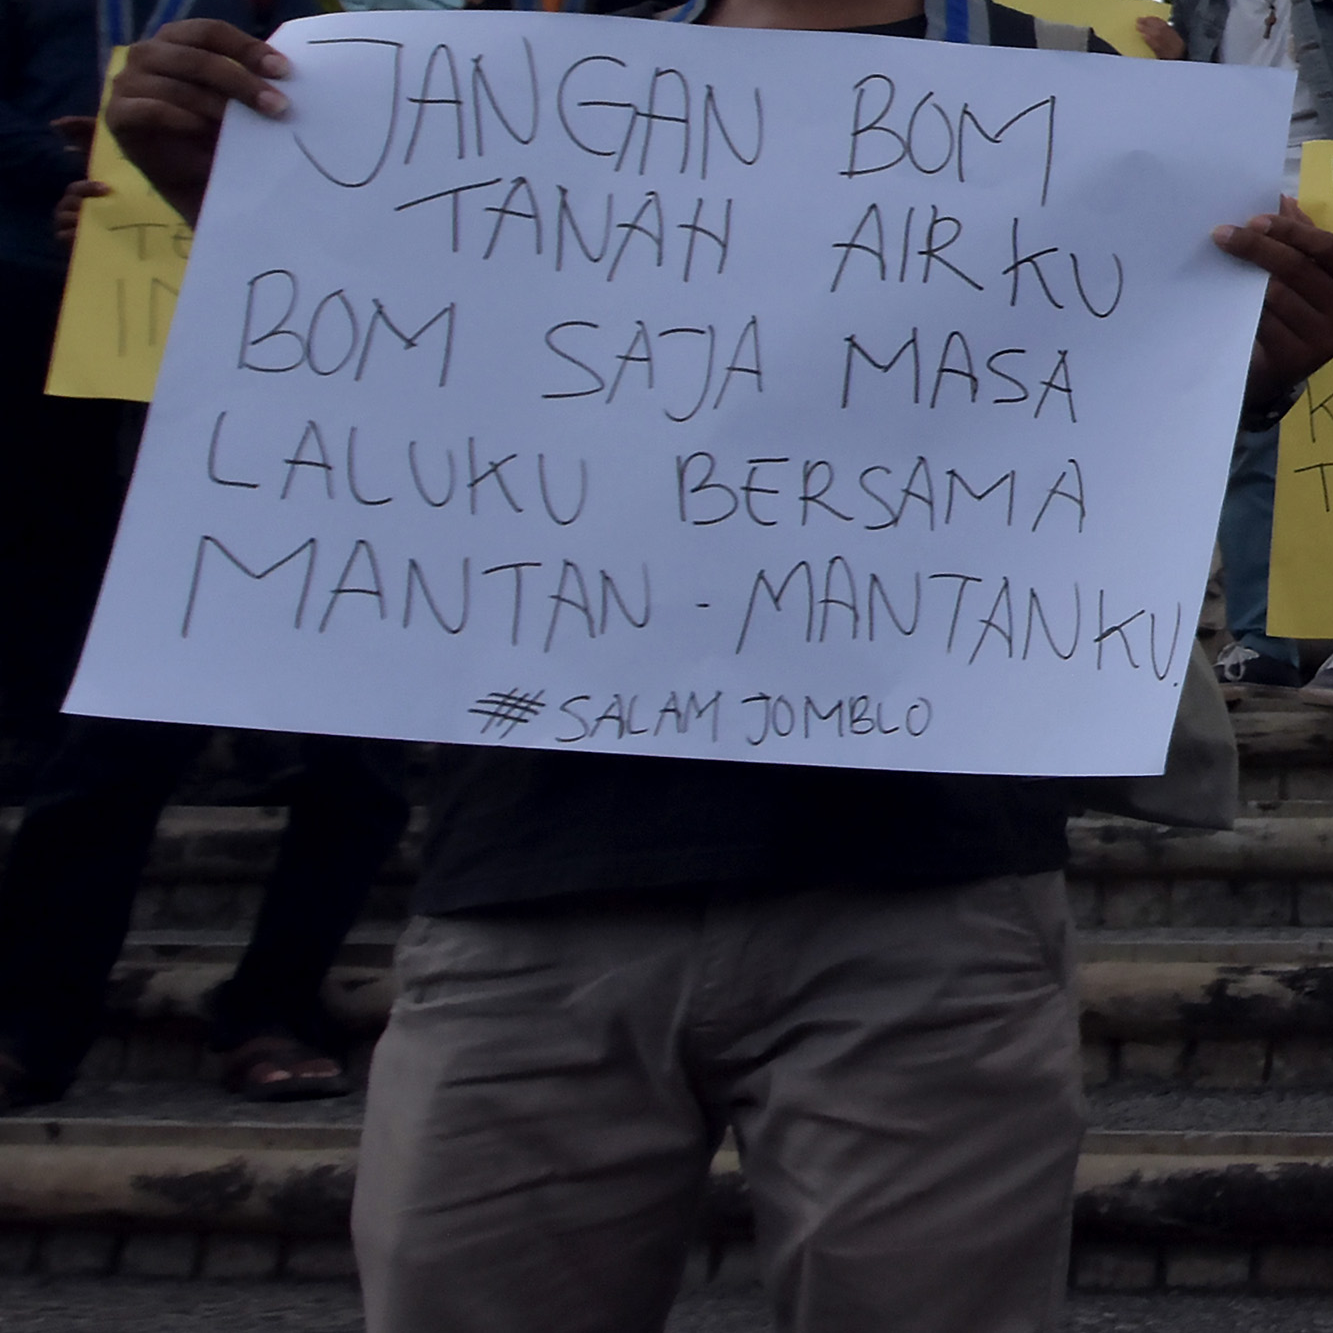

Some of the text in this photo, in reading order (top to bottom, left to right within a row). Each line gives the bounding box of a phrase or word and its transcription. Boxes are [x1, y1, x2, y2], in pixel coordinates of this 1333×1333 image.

[293, 37, 1055, 206] JANGAN BOM
[395, 177, 731, 282] TANAH
[238, 269, 1076, 423] BOM SAJA MASA
[208, 412, 1085, 532] LALUKU BERSAMA
[182, 535, 651, 653] MANTAN
